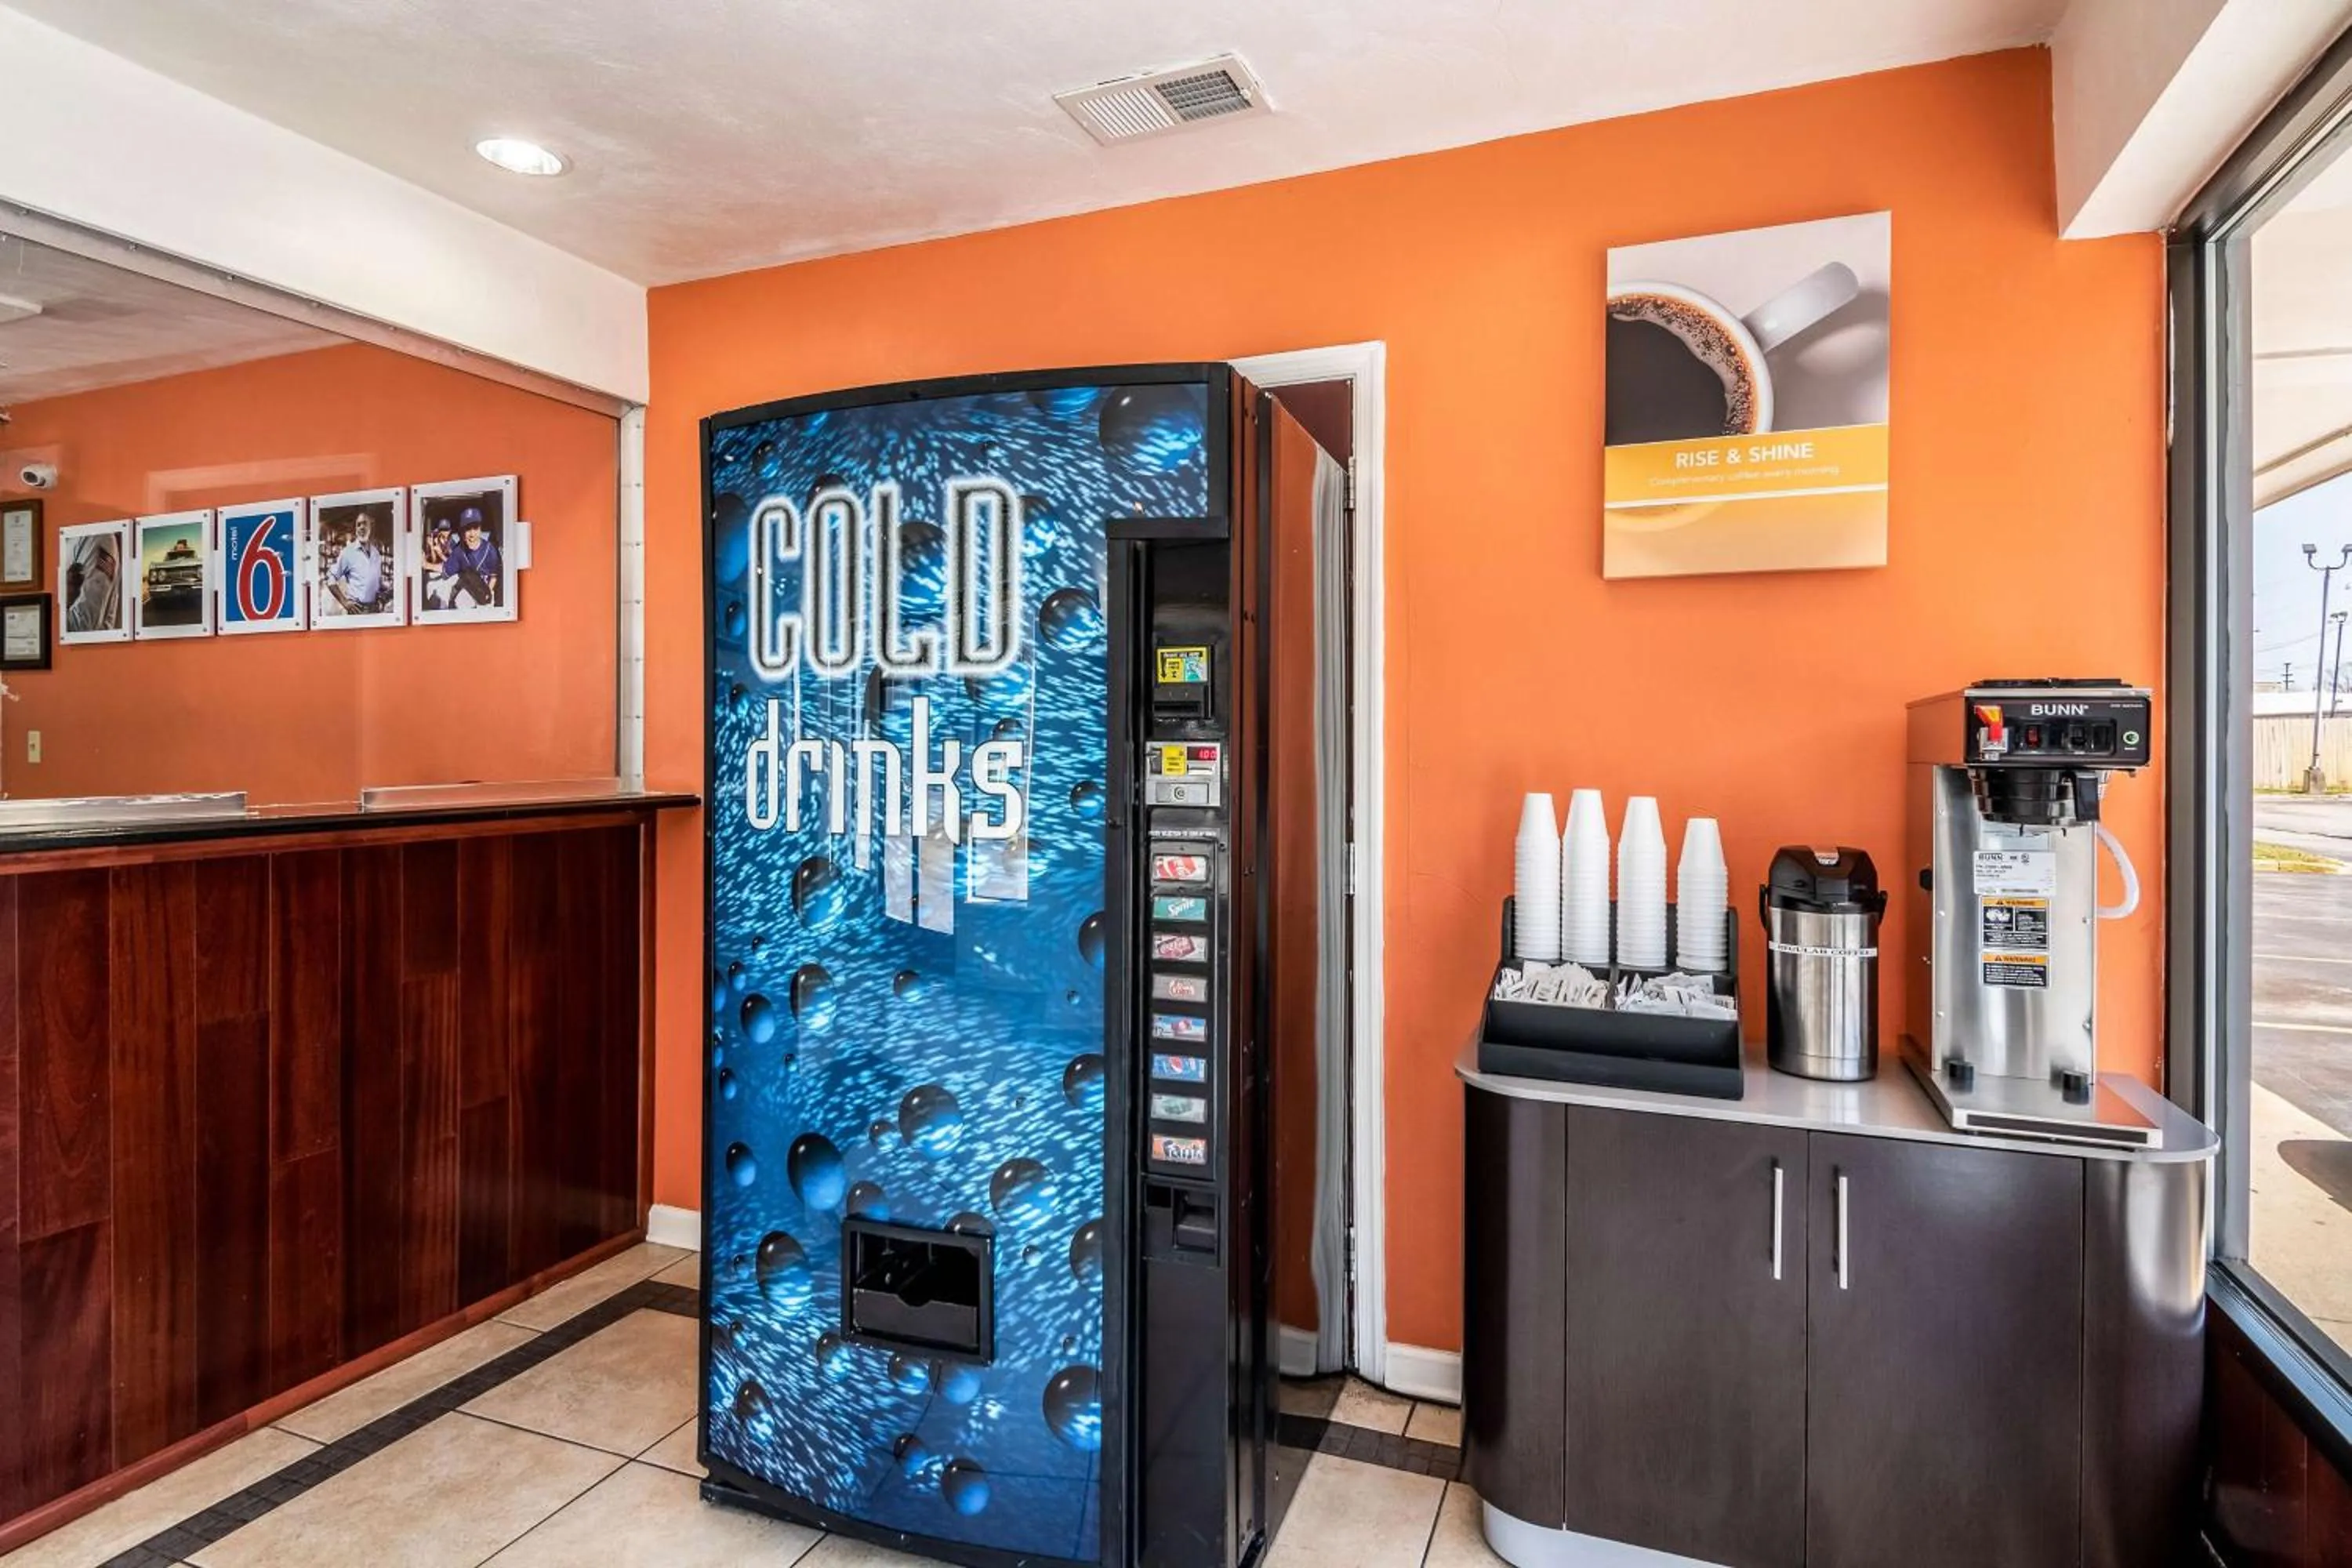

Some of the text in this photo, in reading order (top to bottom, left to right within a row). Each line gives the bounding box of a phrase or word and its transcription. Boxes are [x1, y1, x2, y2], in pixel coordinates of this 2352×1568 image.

[1675, 442, 1814, 468] RISE & SHINE
[236, 515, 286, 621] 6
[748, 477, 1022, 679] COLD
[2031, 704, 2085, 716] BUNN
[746, 696, 1024, 846] drinks
[1167, 898, 1196, 916] Sprite
